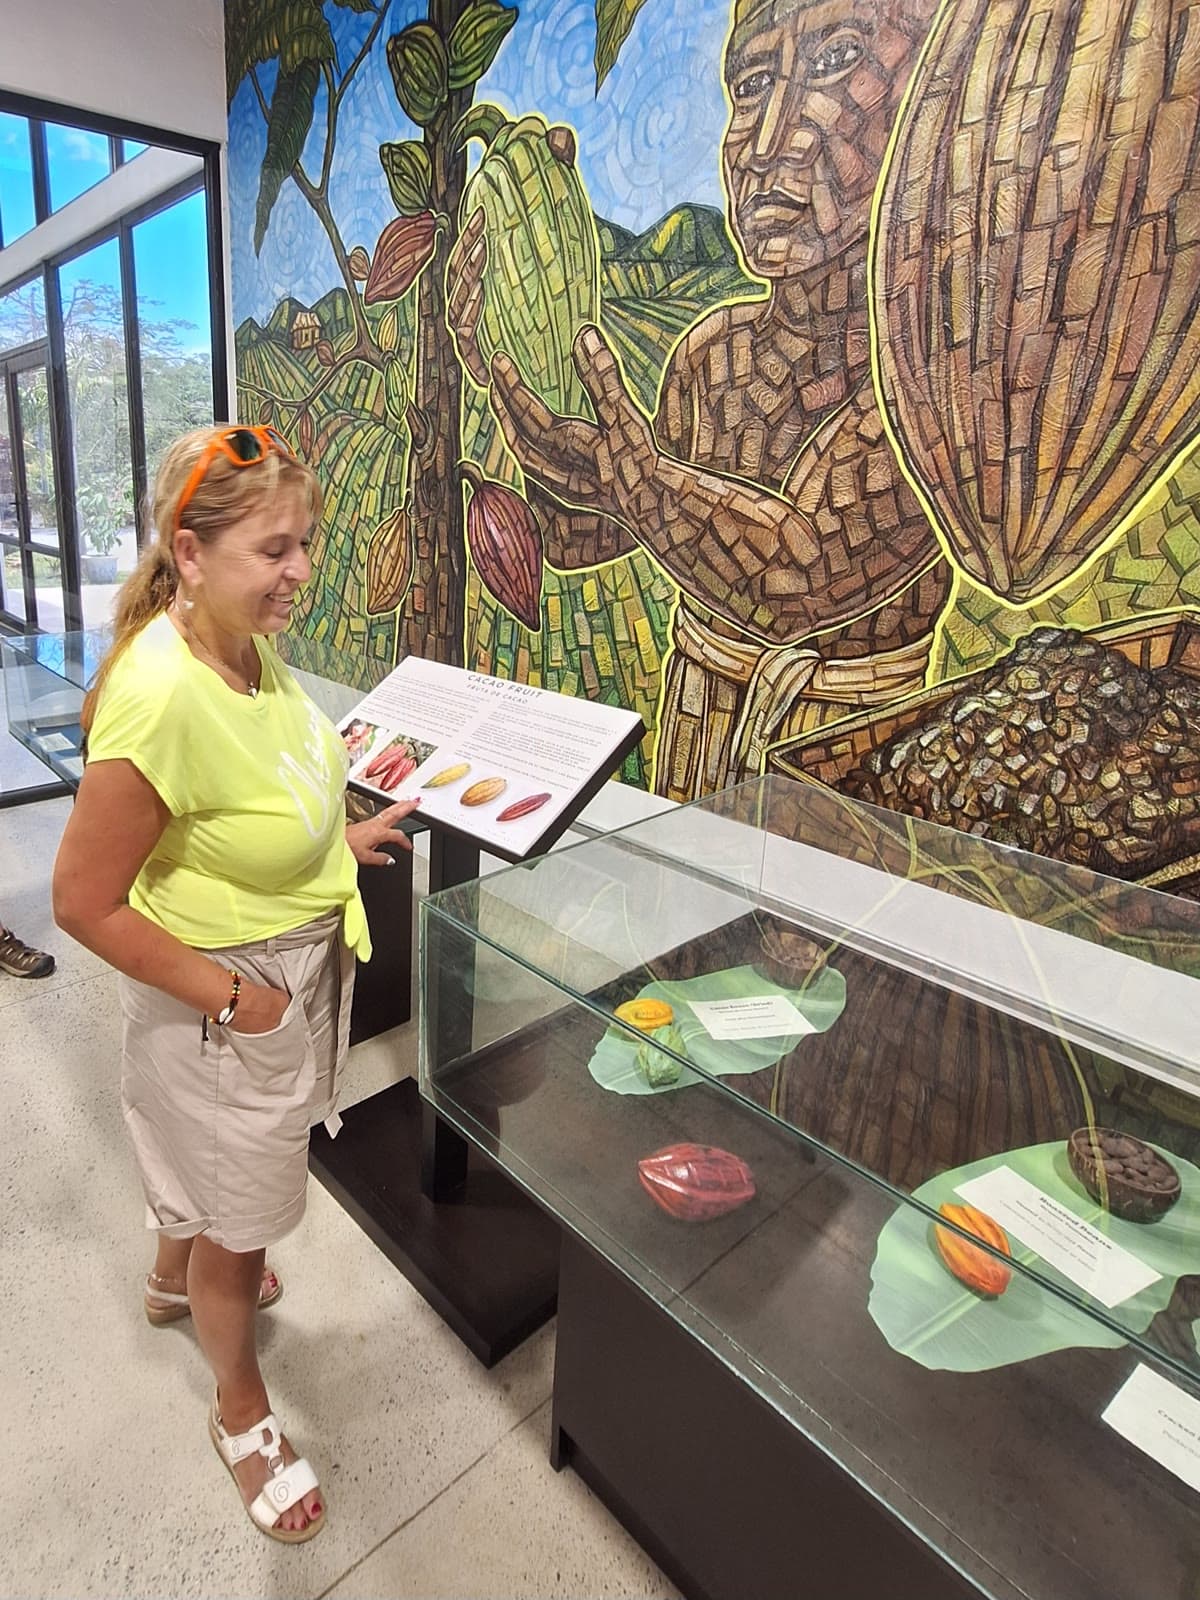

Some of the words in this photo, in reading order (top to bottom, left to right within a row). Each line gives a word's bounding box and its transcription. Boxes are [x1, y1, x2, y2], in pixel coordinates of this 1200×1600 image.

[467, 684, 489, 693] FRUTA
[503, 694, 528, 704] CACAO
[468, 675, 505, 688] CACAO
[508, 685, 543, 698] FRUIT
